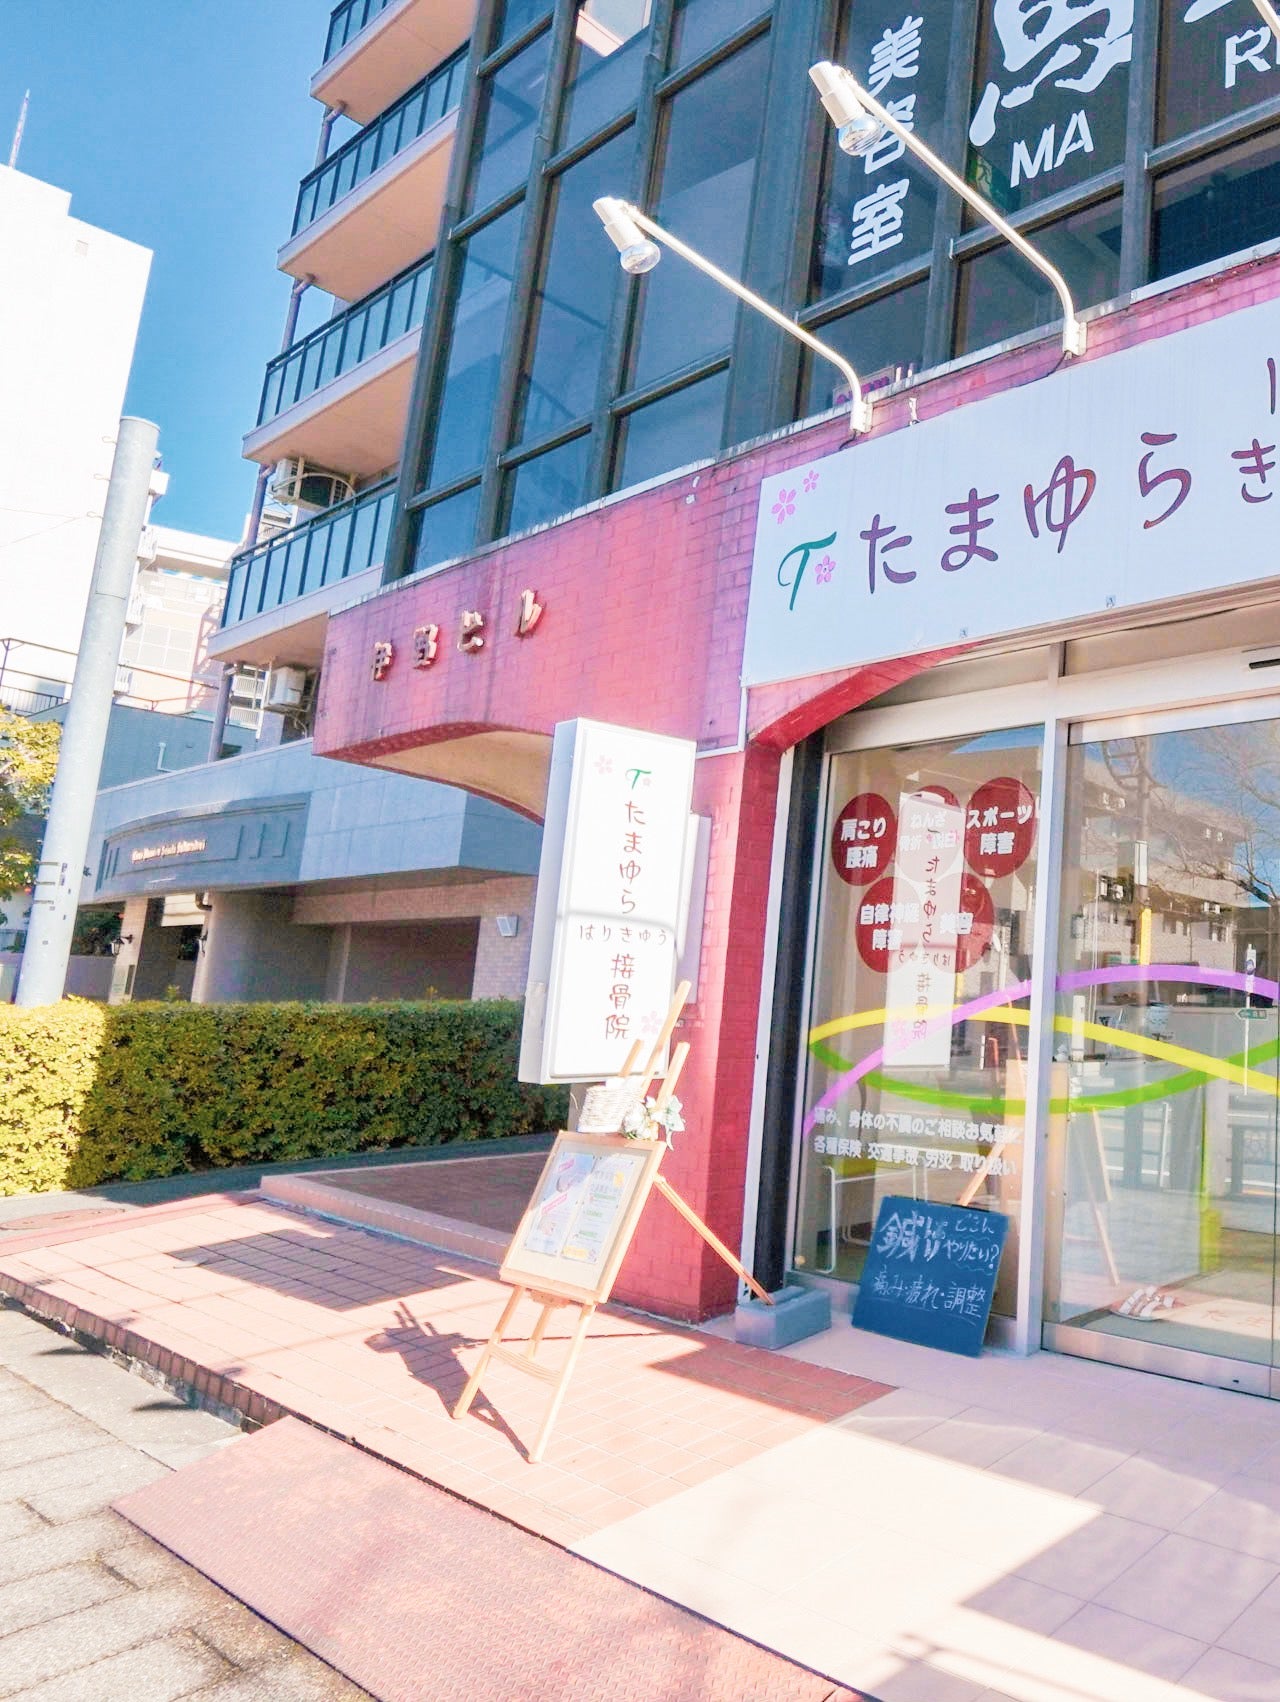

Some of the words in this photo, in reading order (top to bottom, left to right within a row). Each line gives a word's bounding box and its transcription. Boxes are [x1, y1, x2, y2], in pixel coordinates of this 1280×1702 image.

[1010, 109, 1095, 188] MA
[859, 429, 1193, 595] たまゆら
[840, 816, 887, 842] 肩こり
[966, 804, 1033, 830] スポーツ
[618, 800, 646, 915] たまゆら
[979, 831, 1016, 856] 障害
[577, 923, 668, 945] はりきゅう
[603, 952, 637, 1040] 接骨院
